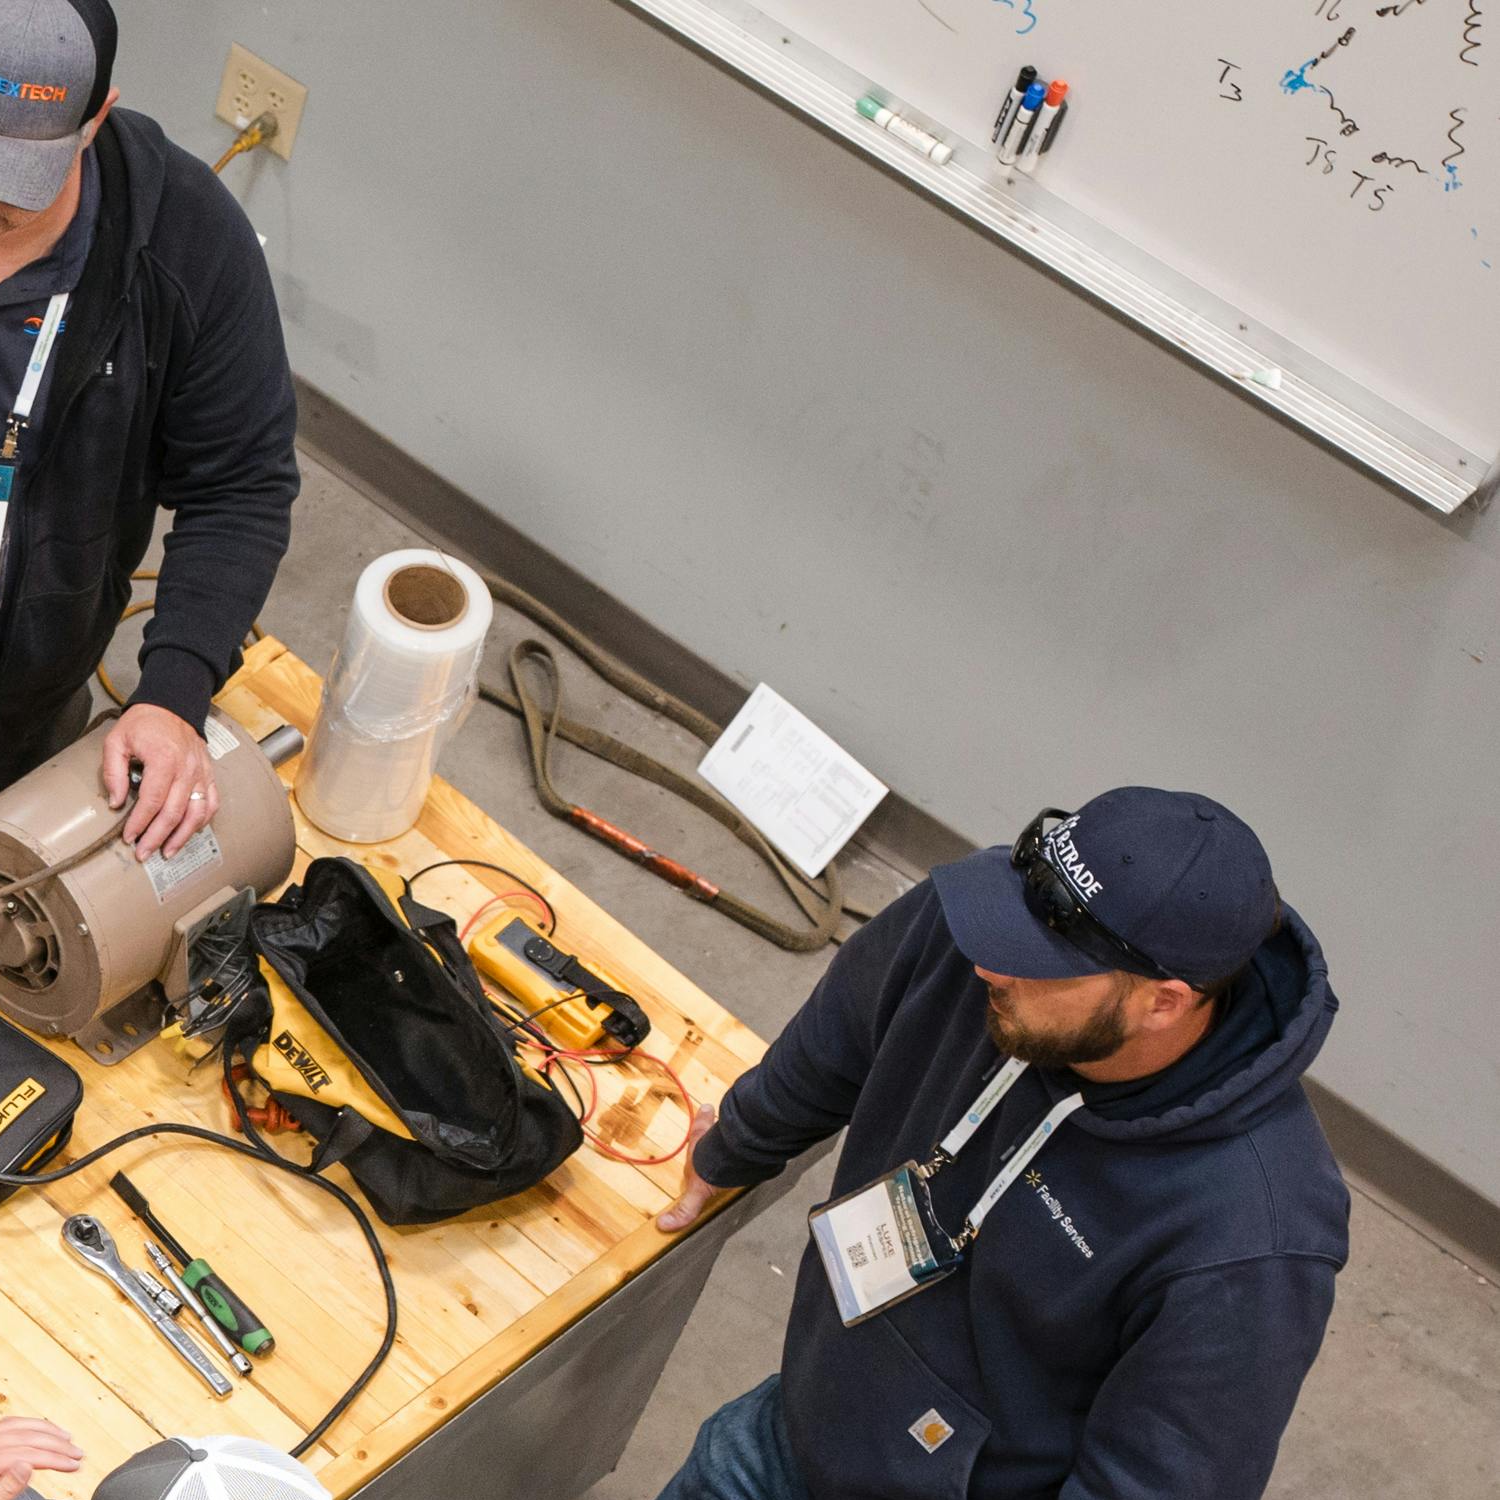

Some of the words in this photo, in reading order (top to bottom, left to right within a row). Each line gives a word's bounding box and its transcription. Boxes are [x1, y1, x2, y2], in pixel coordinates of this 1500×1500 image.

[272, 1031, 330, 1093] DEWALT
[876, 1222, 898, 1257] LUKE
[1035, 1184, 1066, 1218] Facility
[1059, 1215, 1094, 1258] Services
